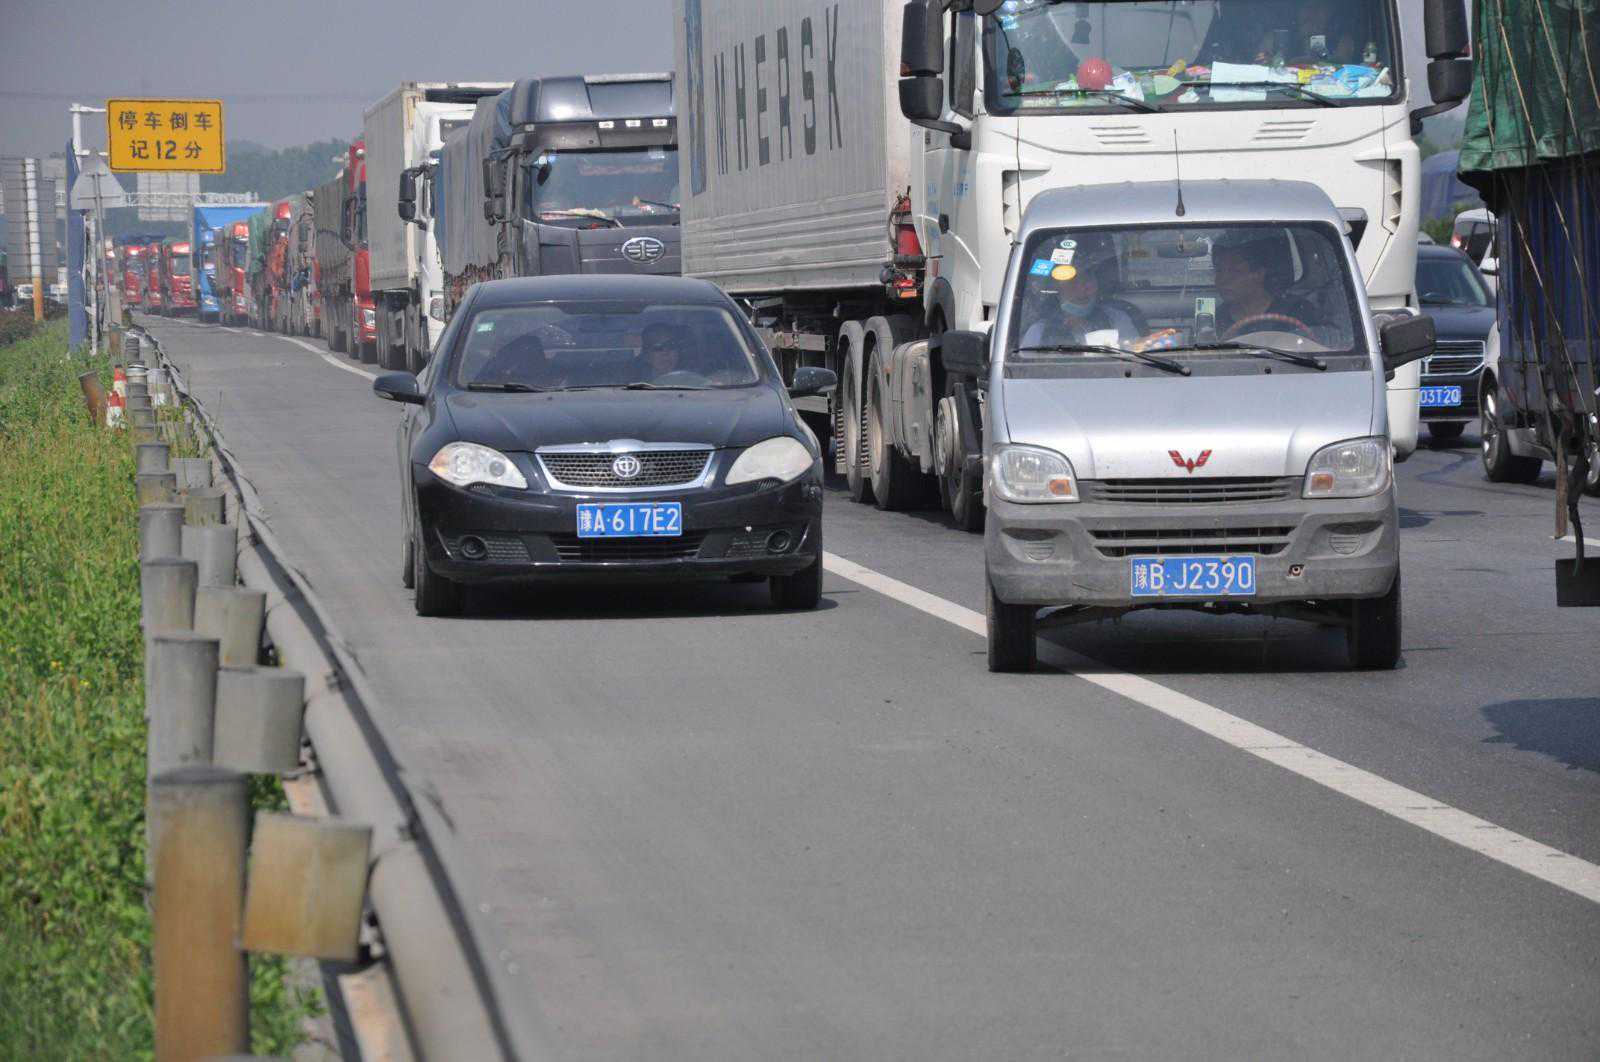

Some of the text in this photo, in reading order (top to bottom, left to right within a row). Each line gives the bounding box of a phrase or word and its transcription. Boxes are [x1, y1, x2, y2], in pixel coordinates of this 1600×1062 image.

[118, 110, 213, 131] 停车倒车
[129, 139, 203, 159] 记12分
